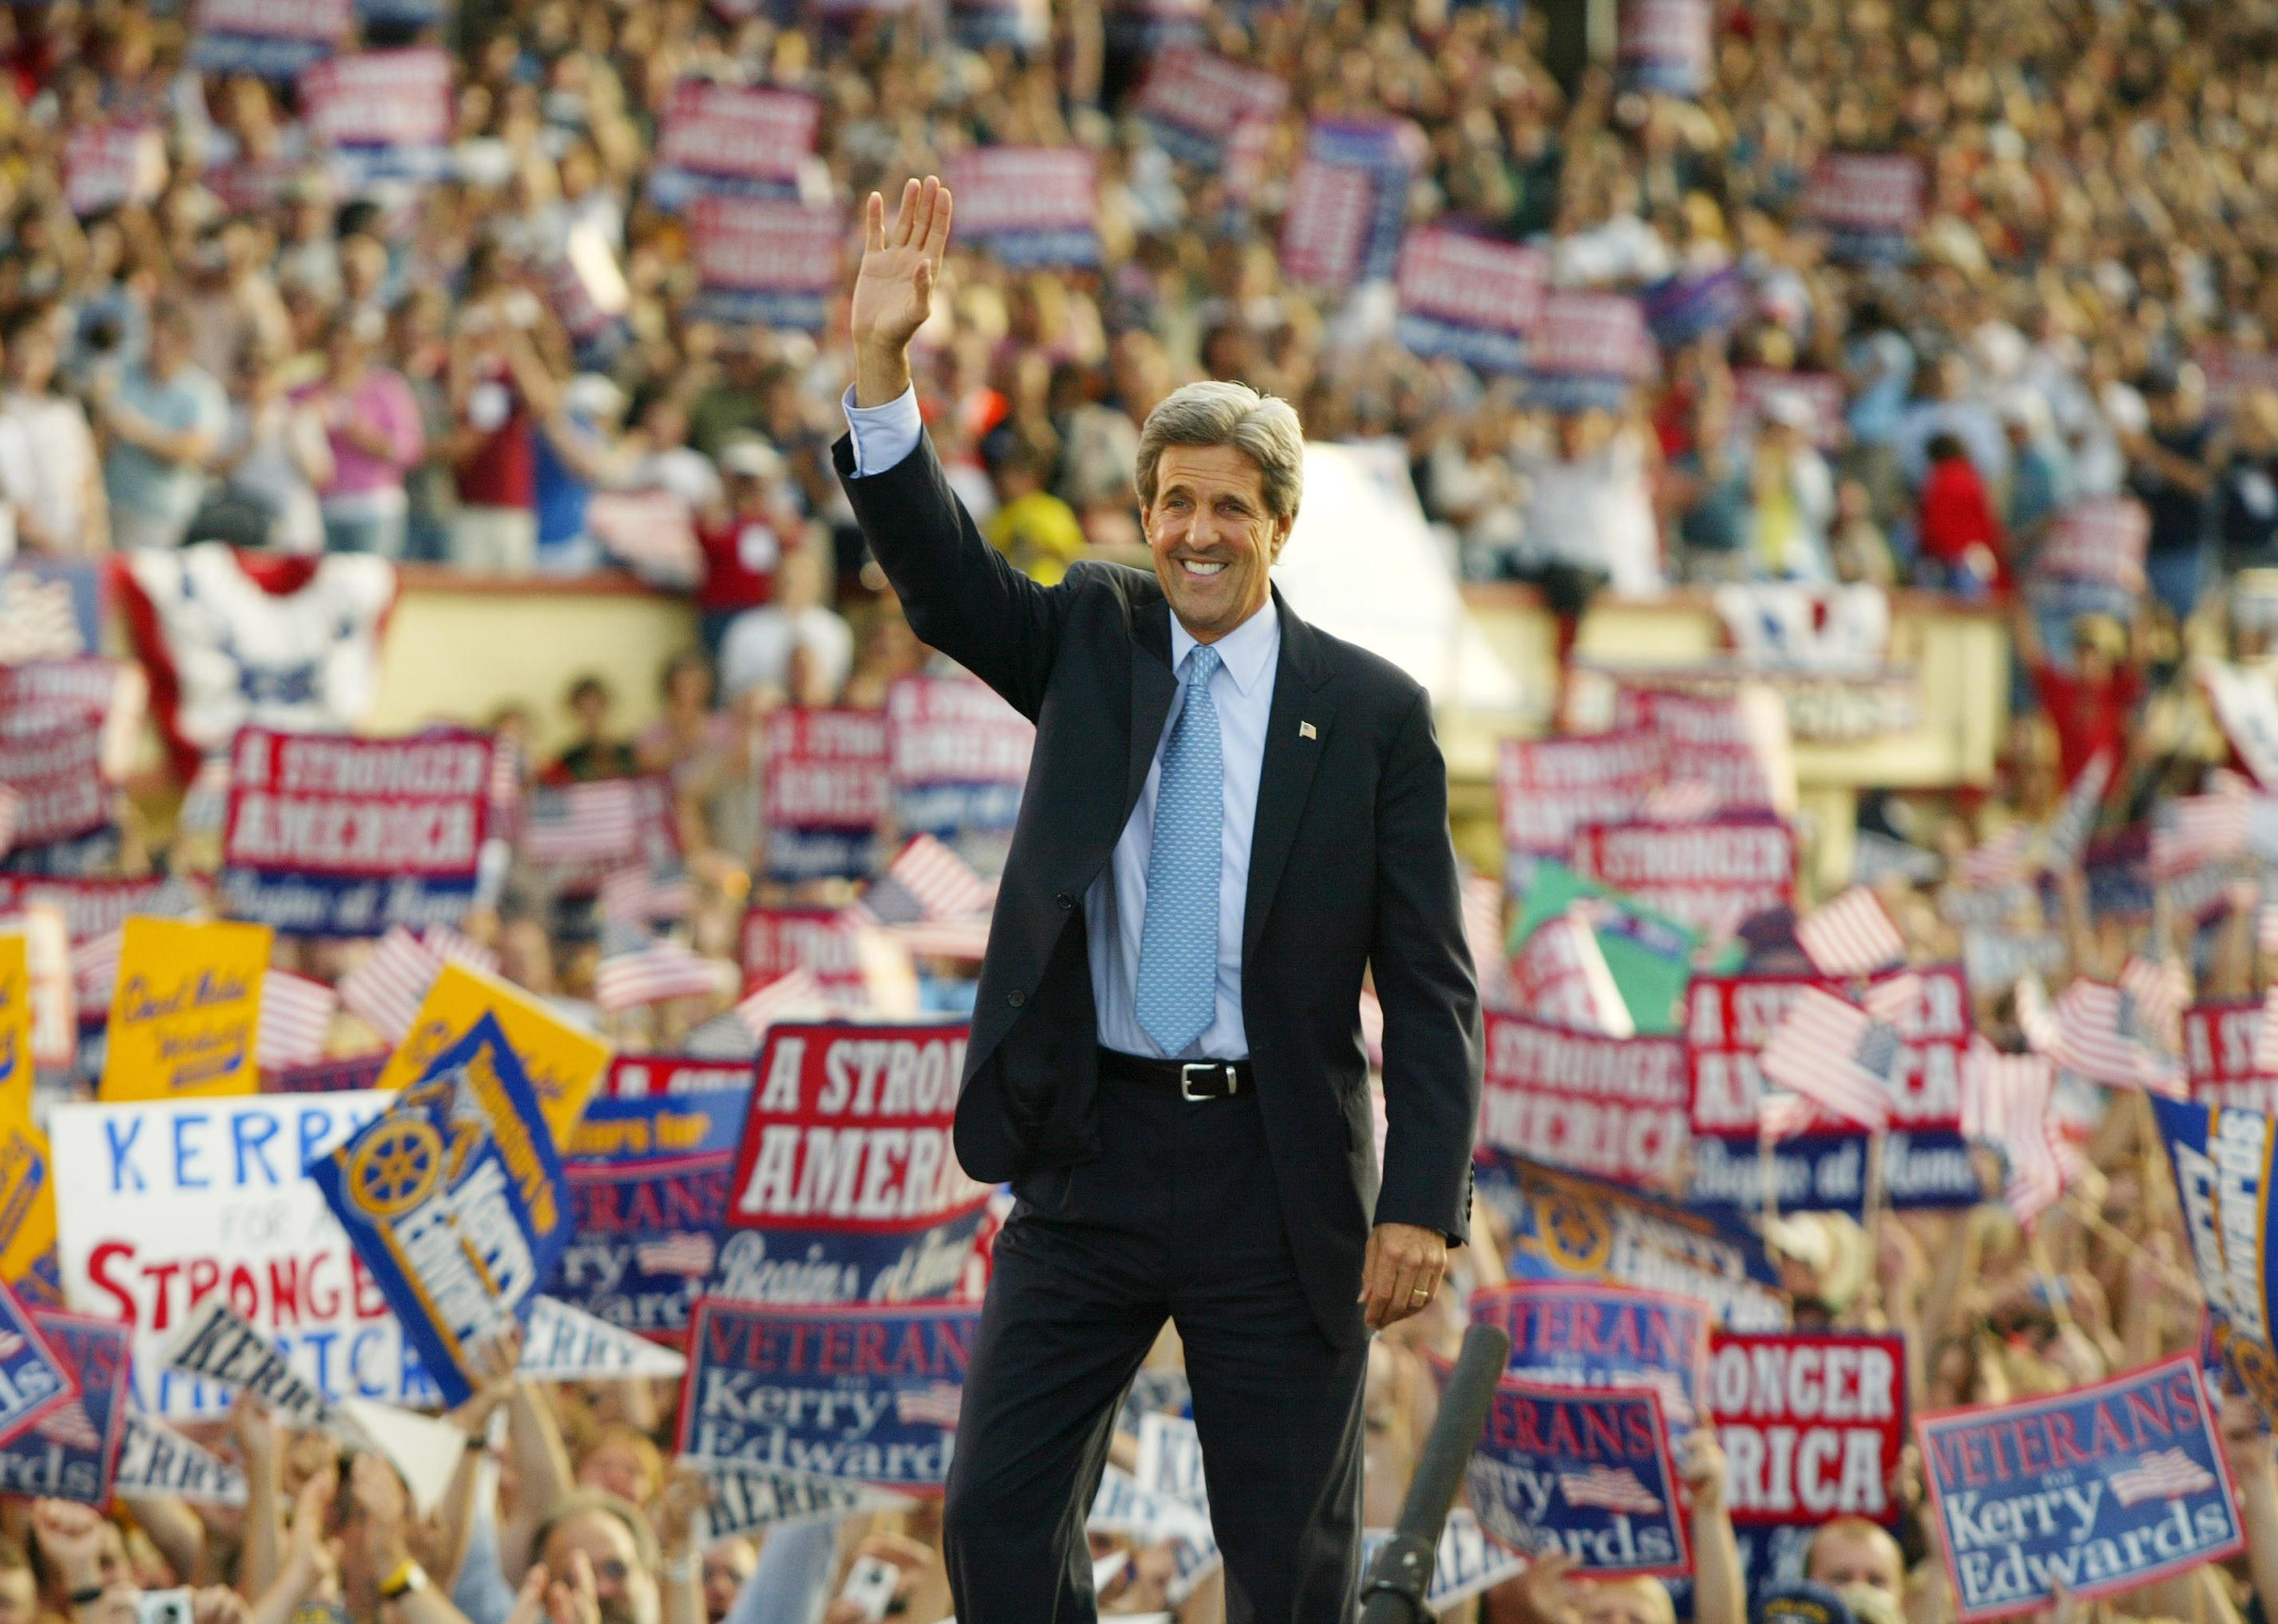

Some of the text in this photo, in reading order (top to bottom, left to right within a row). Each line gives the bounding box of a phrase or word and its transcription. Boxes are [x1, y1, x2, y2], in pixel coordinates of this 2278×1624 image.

[759, 1036, 807, 1115] A
[737, 1123, 958, 1222] AMER
[86, 1238, 391, 1334] STRONGE
[171, 1304, 331, 1425] KERRY
[521, 1305, 636, 1369] ERRY
[706, 1313, 976, 1377] VETERAN
[701, 1366, 890, 1441] Kerry
[1709, 1342, 1895, 1423] ONGER
[118, 1420, 233, 1494] ERRY
[696, 1420, 958, 1479] Edward
[1479, 1395, 1657, 1462] ERANS
[1930, 1369, 2201, 1491] VETERANS
[1722, 1423, 1887, 1515] RICA
[1943, 1478, 2104, 1551] Kerry
[1959, 1499, 2230, 1607] Edwards
